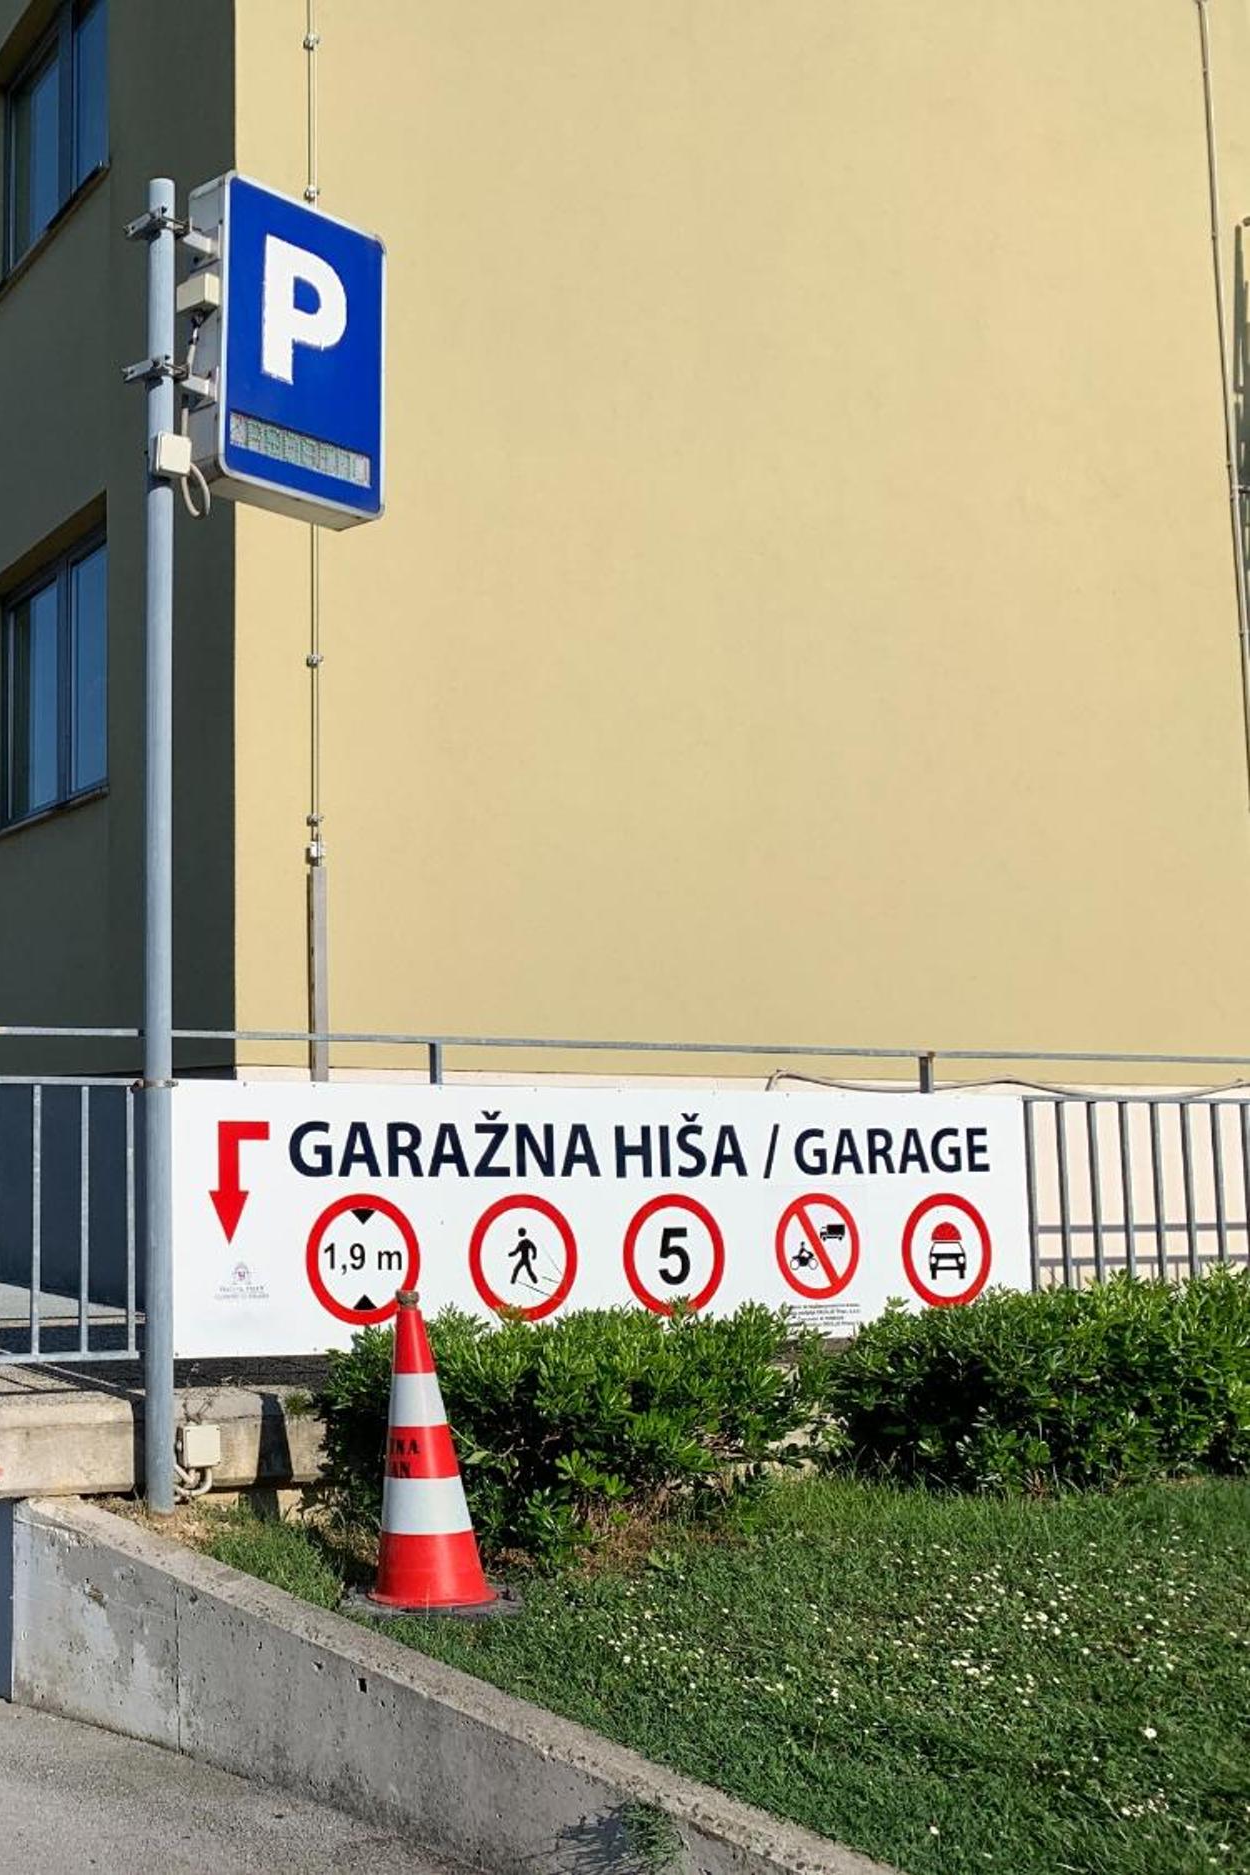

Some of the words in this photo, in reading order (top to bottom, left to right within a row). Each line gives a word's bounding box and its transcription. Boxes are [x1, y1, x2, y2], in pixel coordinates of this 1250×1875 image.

[262, 235, 347, 384] P
[289, 1111, 602, 1178] GARAŽNA
[614, 1112, 748, 1178] HIŠA
[763, 1123, 780, 1179] /
[794, 1127, 991, 1176] GARAGE
[324, 1242, 366, 1276] 1,9
[377, 1250, 403, 1271] m
[658, 1226, 691, 1286] 5
